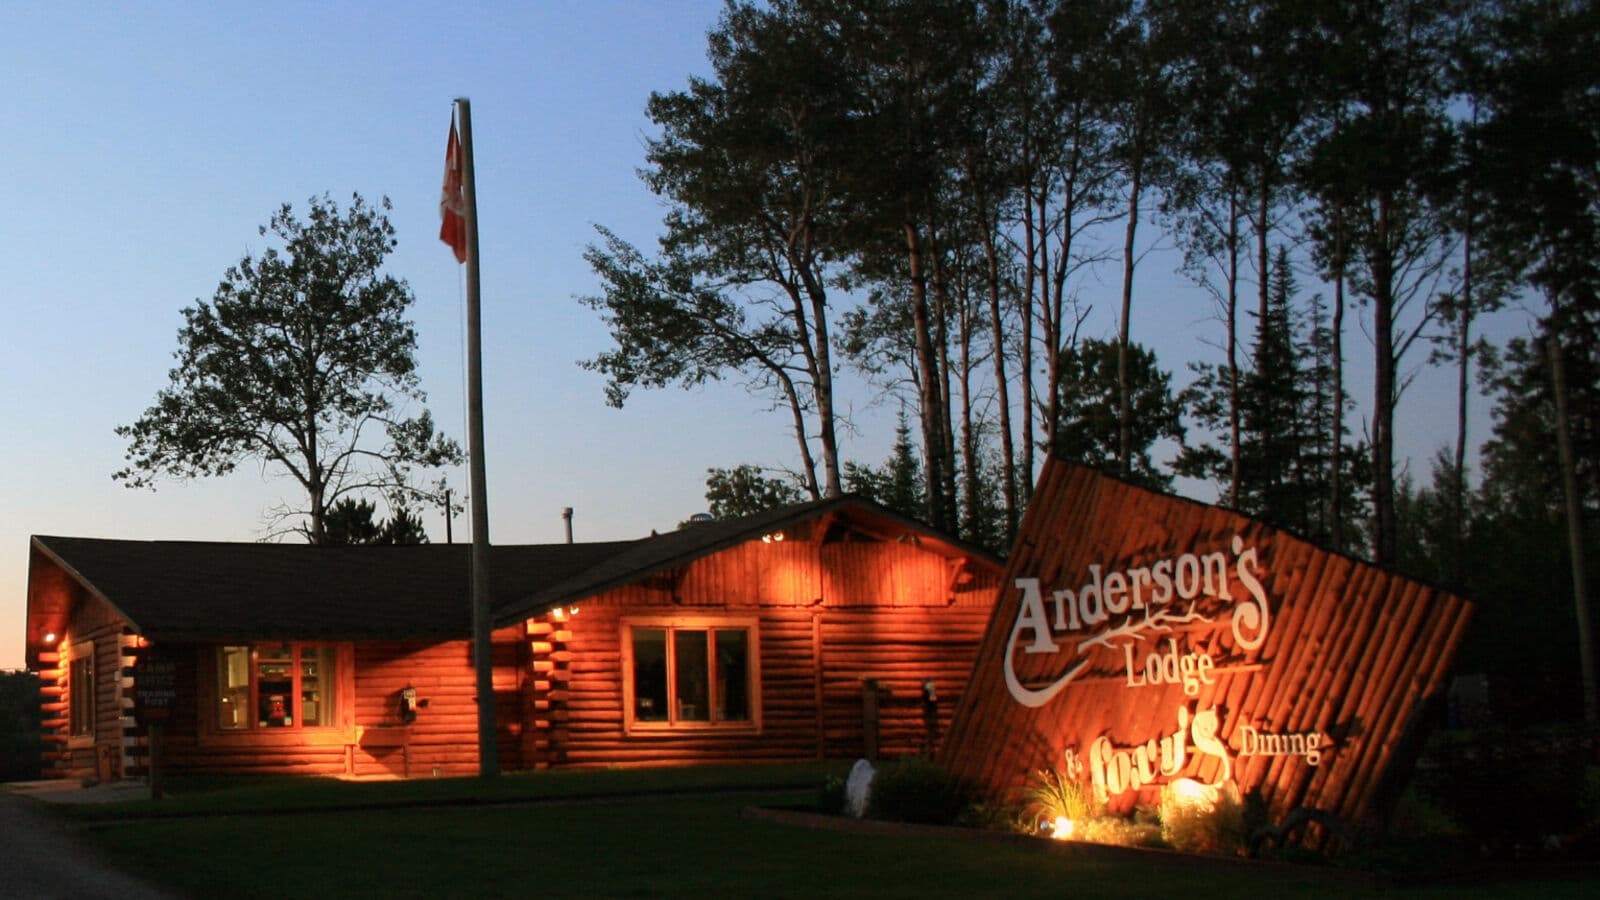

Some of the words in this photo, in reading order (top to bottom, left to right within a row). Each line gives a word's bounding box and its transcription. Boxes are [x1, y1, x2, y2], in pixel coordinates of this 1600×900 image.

[1003, 535, 1270, 708] Anderson's
[1126, 638, 1215, 695] Lodge
[1239, 724, 1322, 765] Dining
